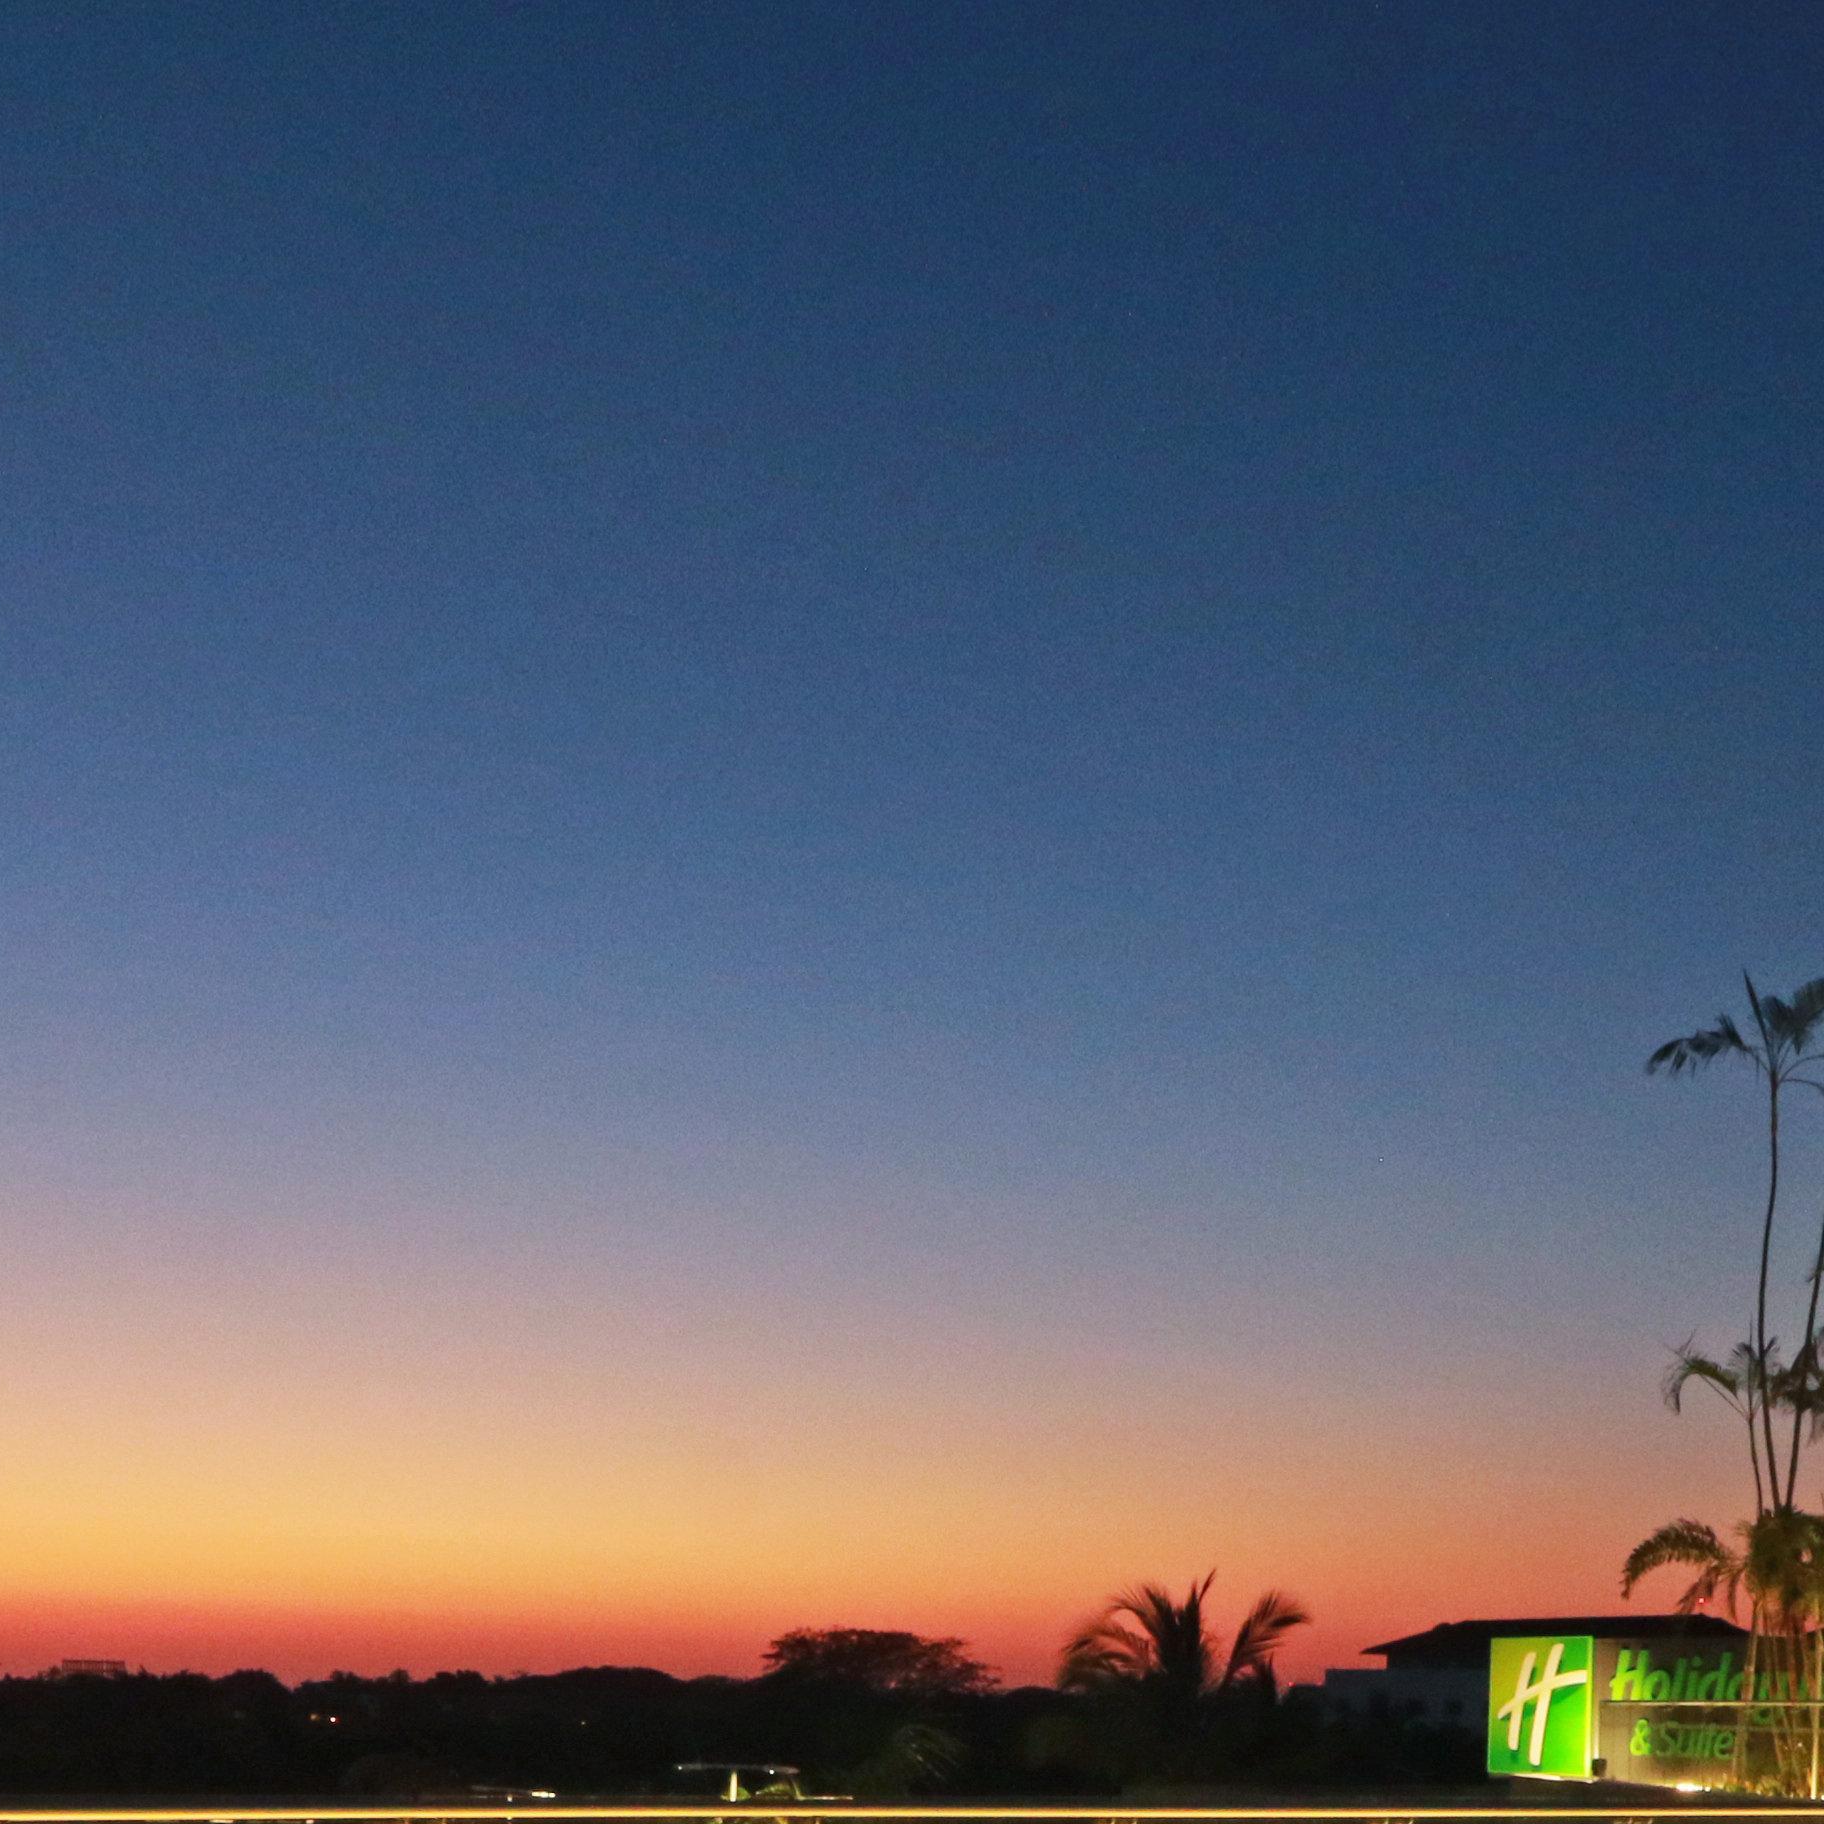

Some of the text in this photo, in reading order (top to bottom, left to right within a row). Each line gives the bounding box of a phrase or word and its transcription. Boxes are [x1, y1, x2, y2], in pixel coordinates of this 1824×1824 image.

[1498, 1644, 1587, 1766] H
[1629, 1718, 1739, 1759] & Suite
